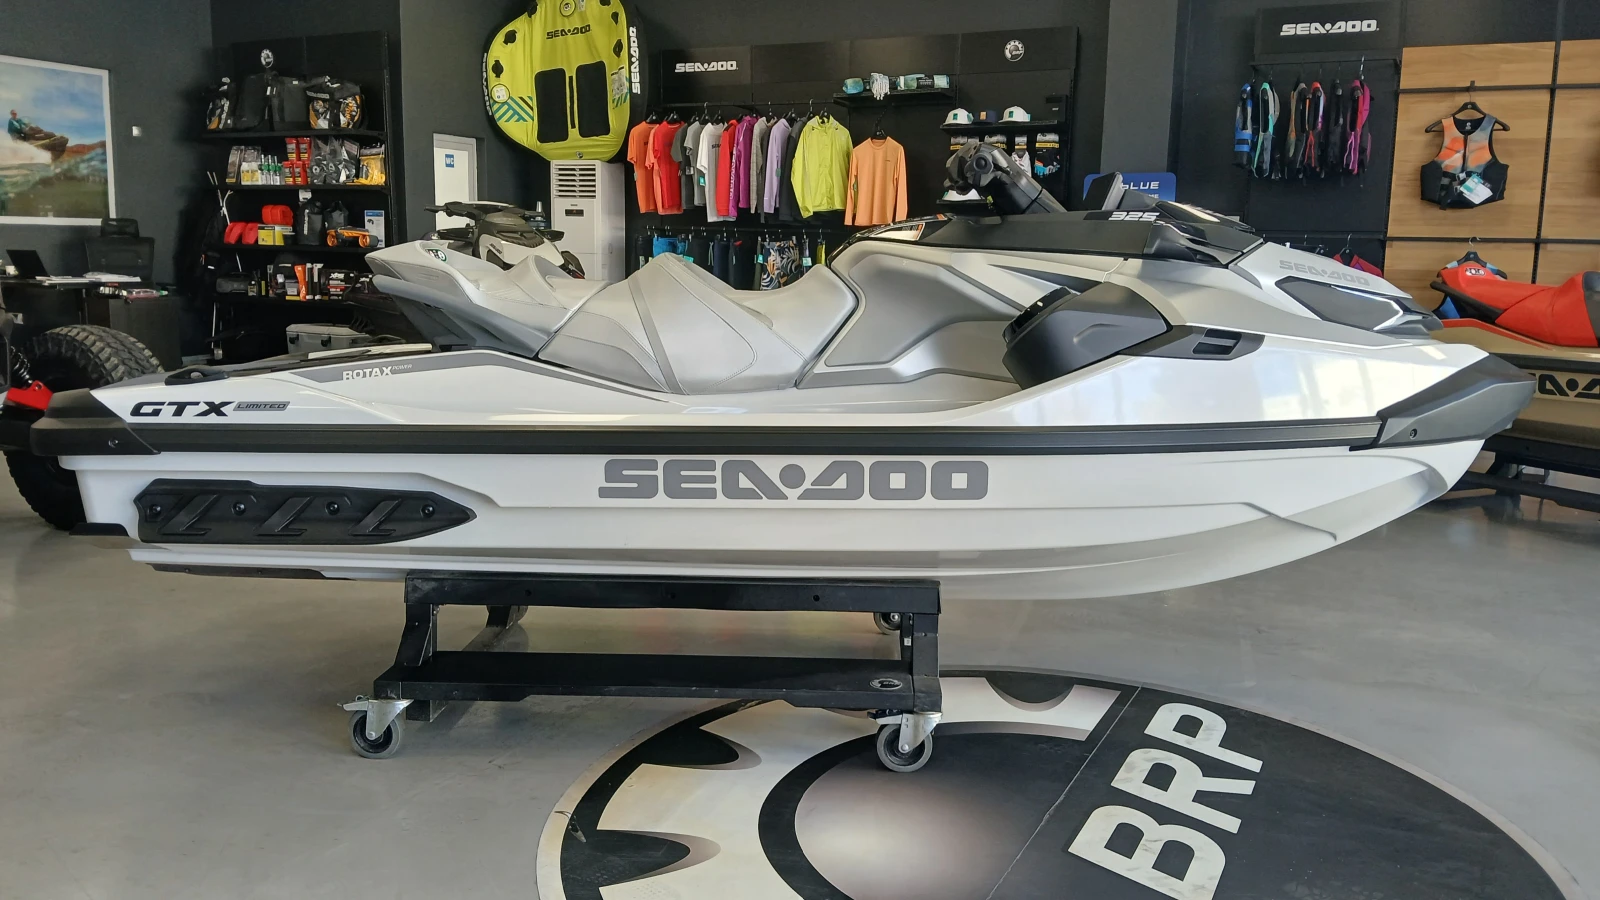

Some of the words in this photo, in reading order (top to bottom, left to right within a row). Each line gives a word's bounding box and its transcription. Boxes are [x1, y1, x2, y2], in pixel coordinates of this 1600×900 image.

[445, 157, 454, 165] WC
[1108, 211, 1160, 222] 325
[342, 366, 392, 381] ROTAX
[130, 401, 235, 417] GTX
[237, 402, 287, 410] LIMITED
[1068, 702, 1263, 900] BRP
